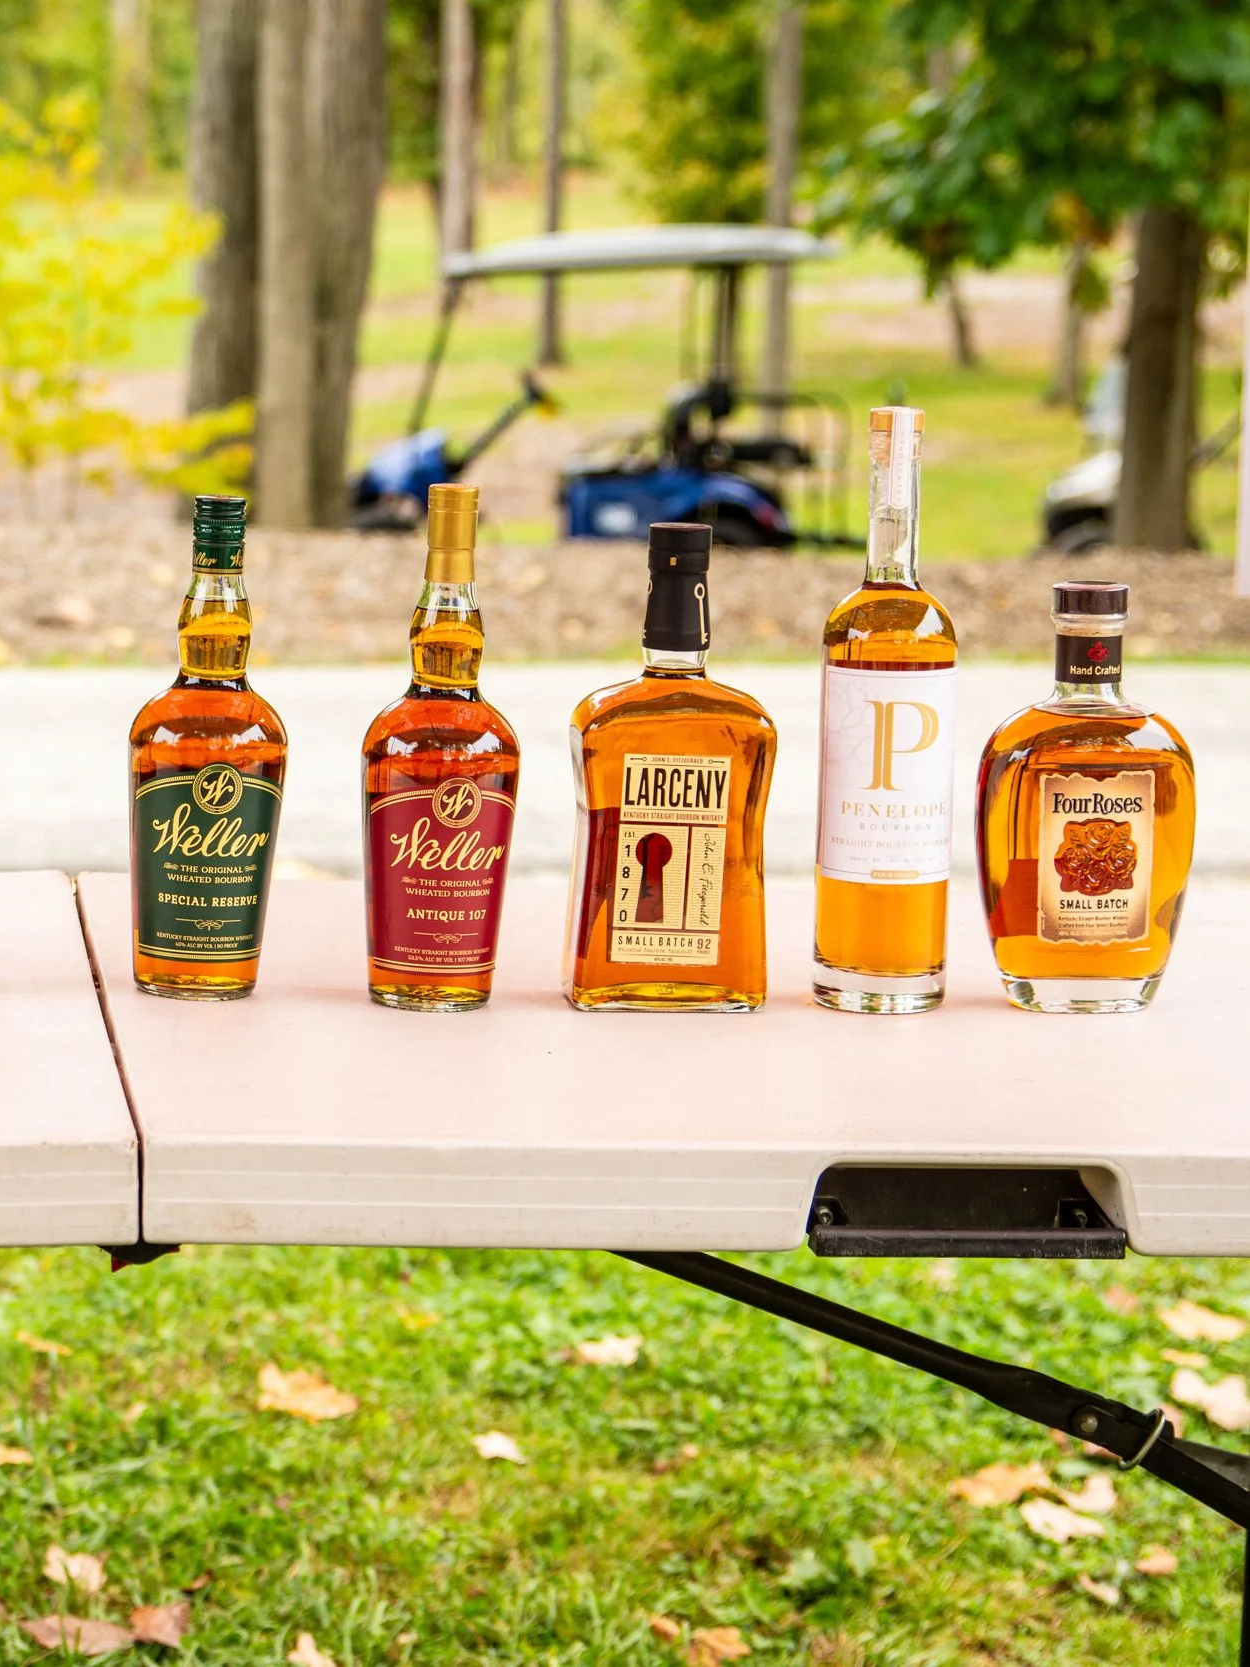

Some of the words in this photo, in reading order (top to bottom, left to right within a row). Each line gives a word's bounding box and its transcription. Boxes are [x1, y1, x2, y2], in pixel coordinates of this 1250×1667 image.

[1070, 665, 1092, 675] Hand
[1095, 664, 1121, 675] Crafted
[624, 767, 727, 809] LARCENY
[1052, 792, 1092, 814] Four
[1092, 792, 1143, 815] Roses
[841, 801, 947, 818] PENELOPE
[623, 811, 649, 819] KENTUCKY
[651, 812, 675, 820] STRAIGHT
[676, 813, 700, 821] BOURBON
[701, 814, 724, 822] WHISKEY
[152, 802, 270, 857] Weller
[859, 823, 931, 831] BOURBON
[390, 817, 506, 871] Weller
[831, 836, 874, 849] STRAIGHT
[180, 864, 199, 873] THE
[201, 866, 244, 874] ORIGINAL
[166, 873, 212, 884] WHEATED
[214, 875, 253, 884] BOURBON
[418, 878, 437, 887] THE
[440, 879, 481, 888] ORIGINAL
[405, 887, 450, 898] WHEATED
[453, 889, 490, 898] BOURBON
[158, 892, 207, 907] SPECIAL
[211, 895, 258, 907] RESERVE
[1059, 899, 1092, 910] SMALL
[1097, 899, 1129, 909] BATCH
[406, 908, 465, 923] ANTIQUE
[469, 909, 486, 920] 107
[156, 931, 183, 940] KENTUCKY
[618, 935, 653, 946] SMALL
[658, 937, 693, 947] BATCH
[697, 938, 711, 949] 92
[394, 946, 421, 954] KENTUCKY
